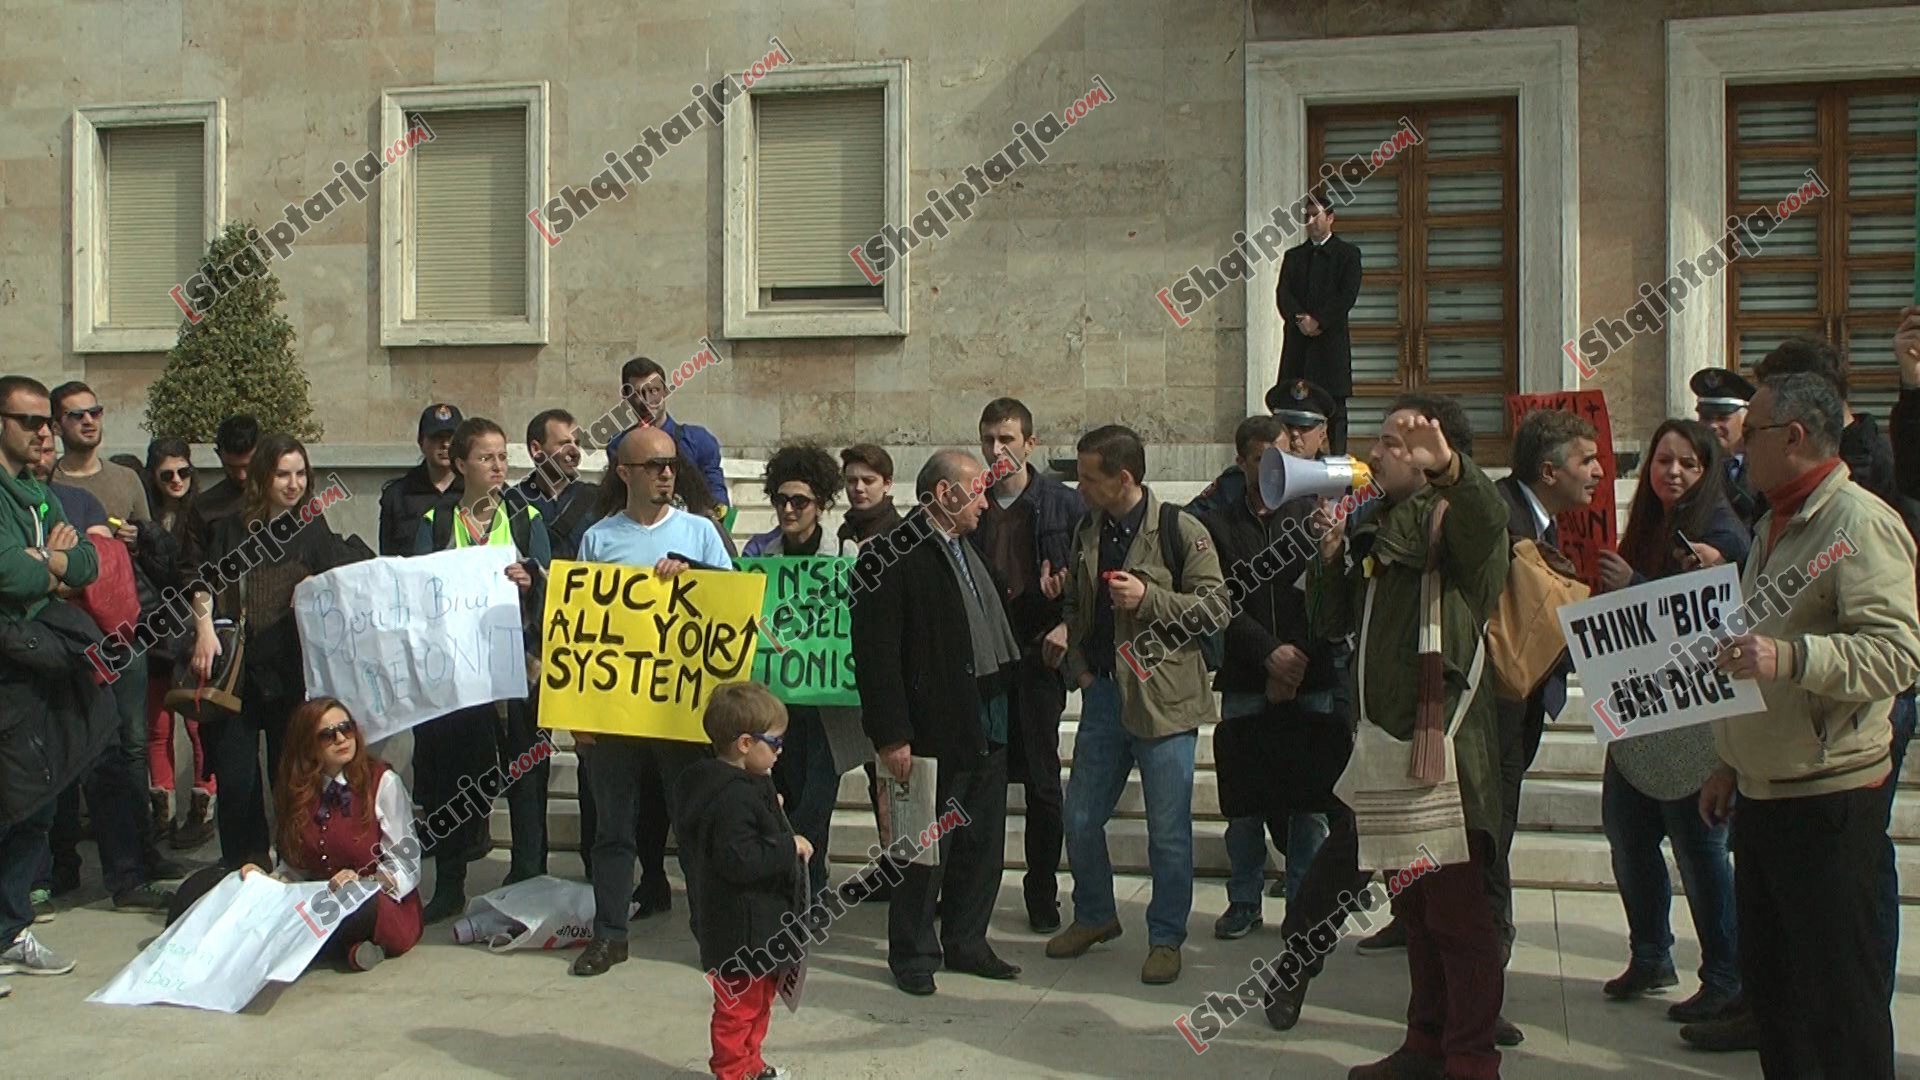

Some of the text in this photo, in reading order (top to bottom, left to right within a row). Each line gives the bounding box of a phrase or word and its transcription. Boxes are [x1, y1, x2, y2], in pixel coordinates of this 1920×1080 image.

[563, 567, 702, 618] FUCK
[1570, 583, 1730, 659] THINK "BIG"
[548, 608, 625, 645] ALL
[546, 646, 702, 712] SYSTEM
